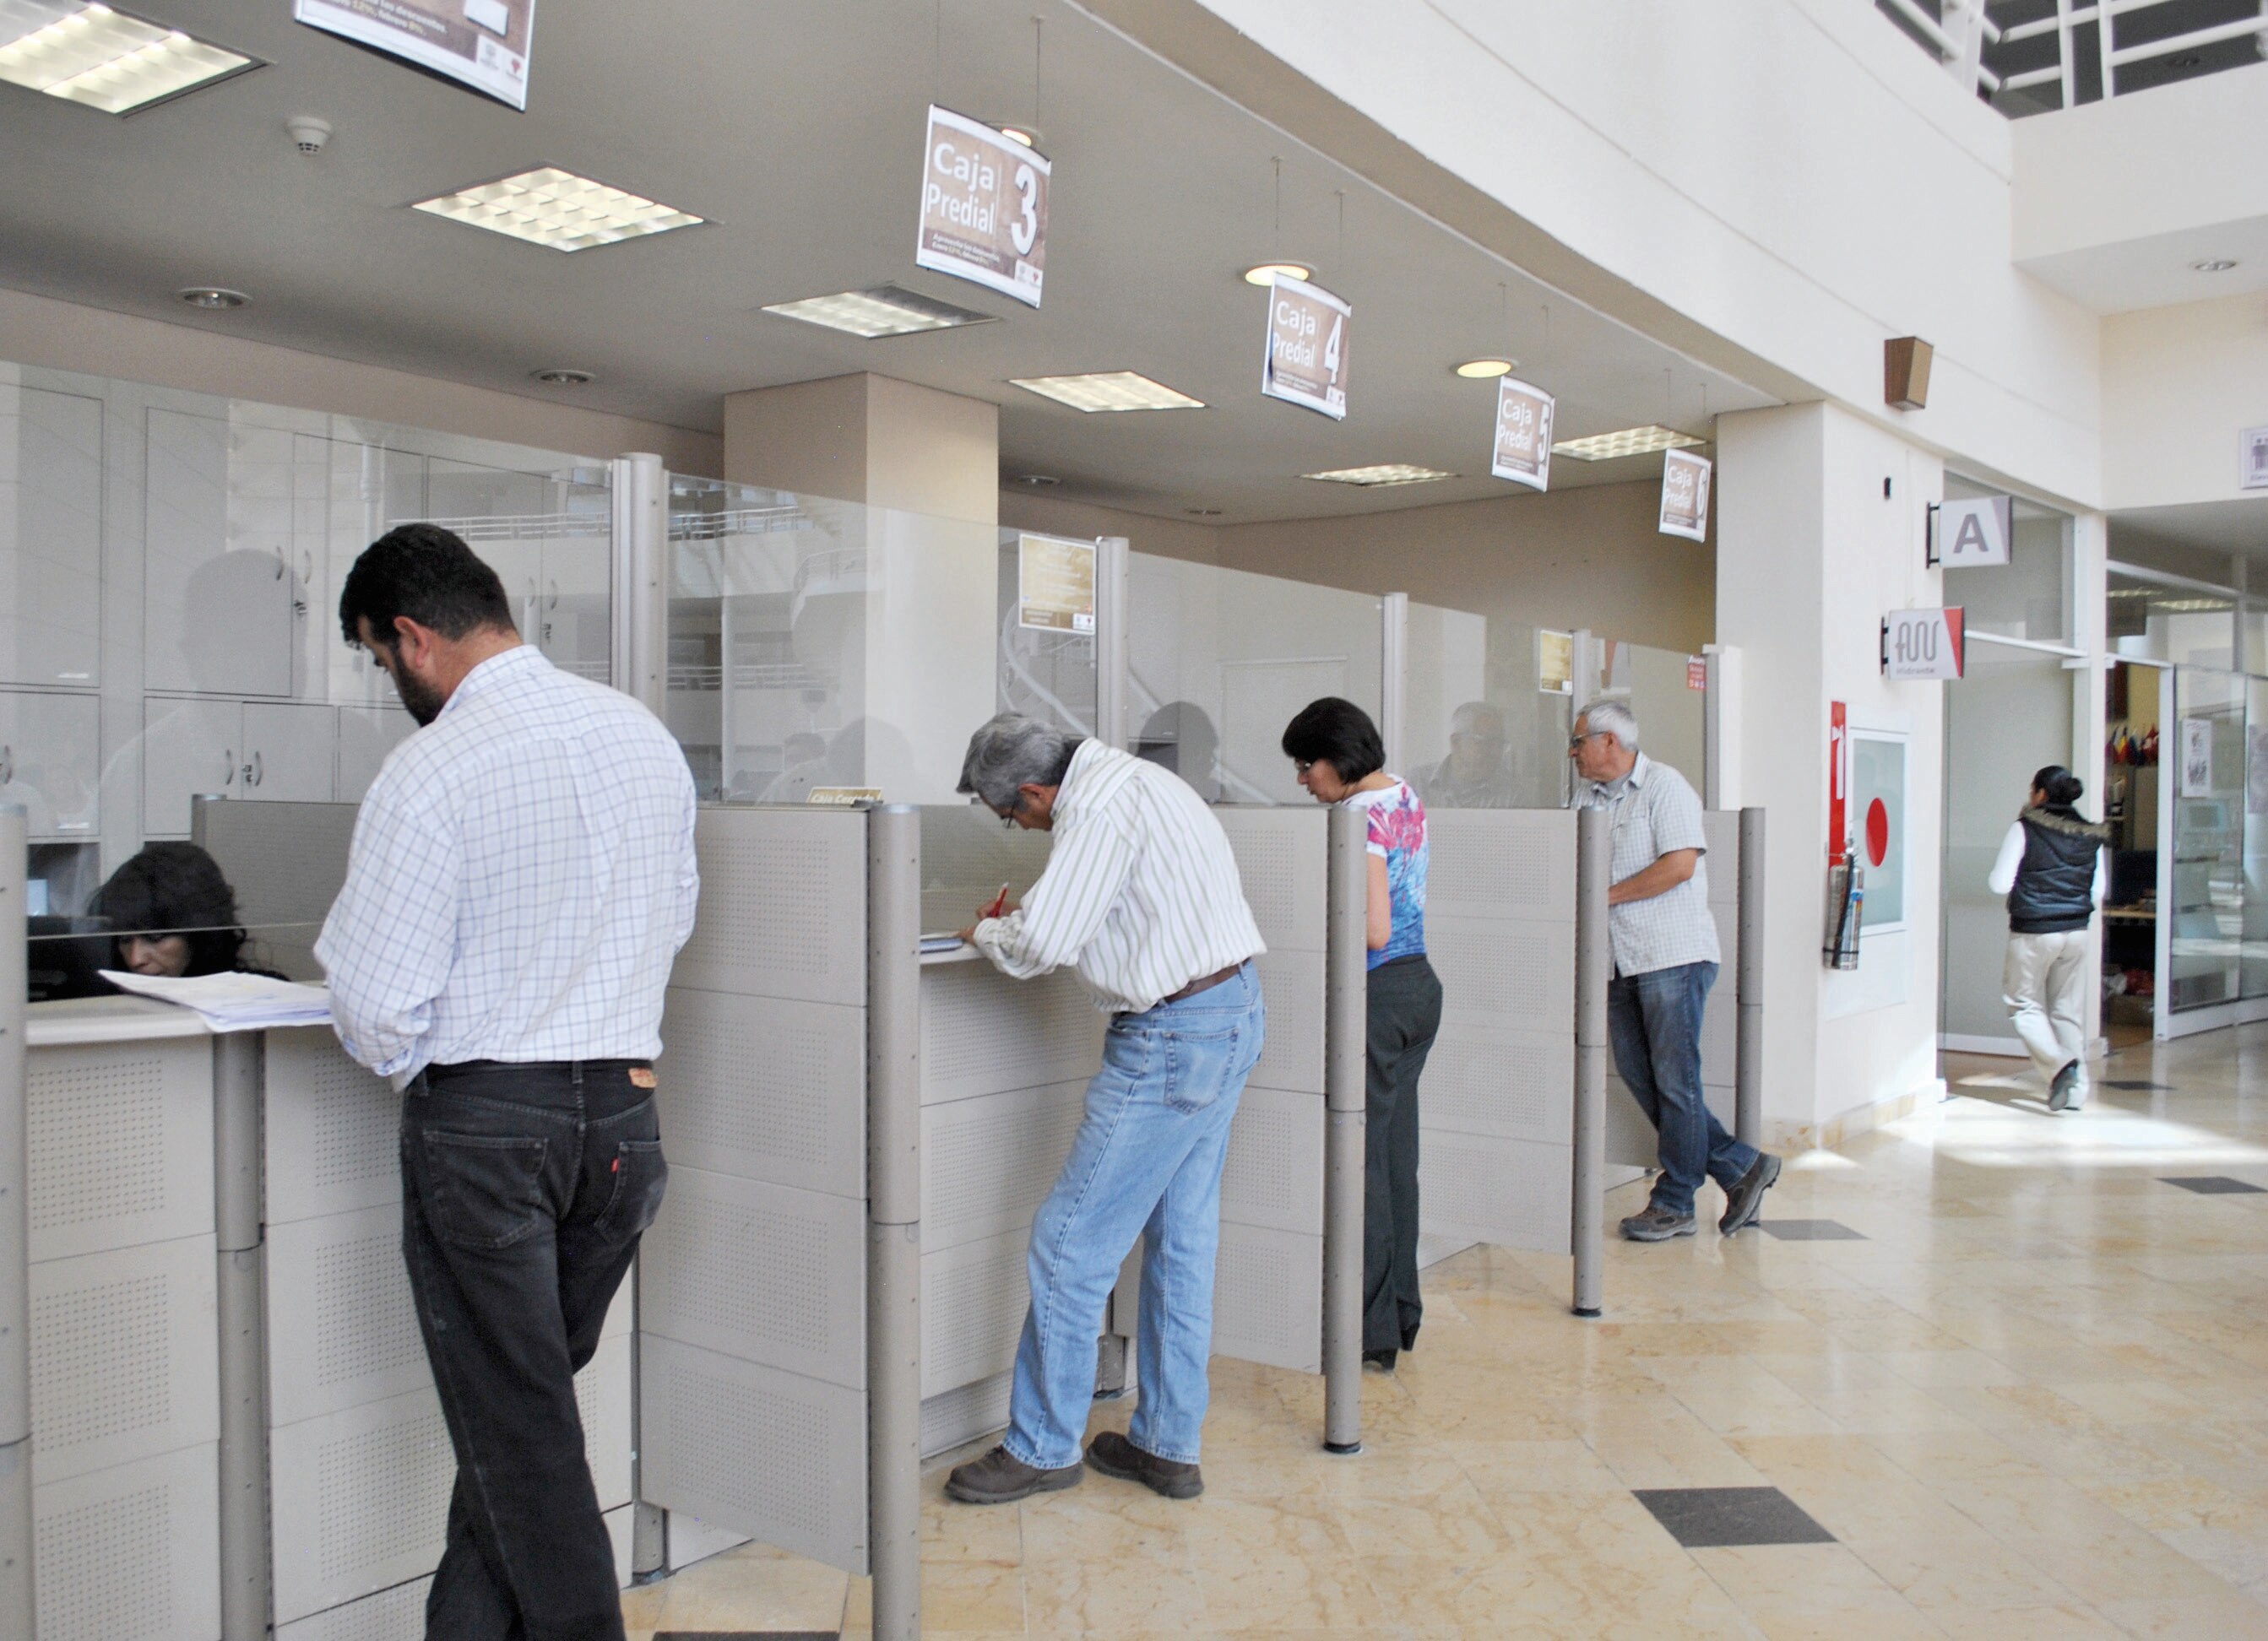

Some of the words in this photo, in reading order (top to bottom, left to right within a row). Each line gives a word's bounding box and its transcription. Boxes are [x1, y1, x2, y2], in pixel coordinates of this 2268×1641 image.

[934, 143, 995, 192] Caja
[927, 183, 995, 235] Predial
[1011, 164, 1037, 255] 3
[1276, 301, 1316, 337] Caja
[1273, 331, 1316, 368] Predial
[1324, 313, 1343, 385] 4
[1502, 398, 1533, 427] Caja
[1537, 403, 1549, 463] 5
[1499, 424, 1533, 452] Predial
[1668, 465, 1693, 489] Caja
[1696, 468, 1706, 517] 6
[1952, 513, 1989, 554] A
